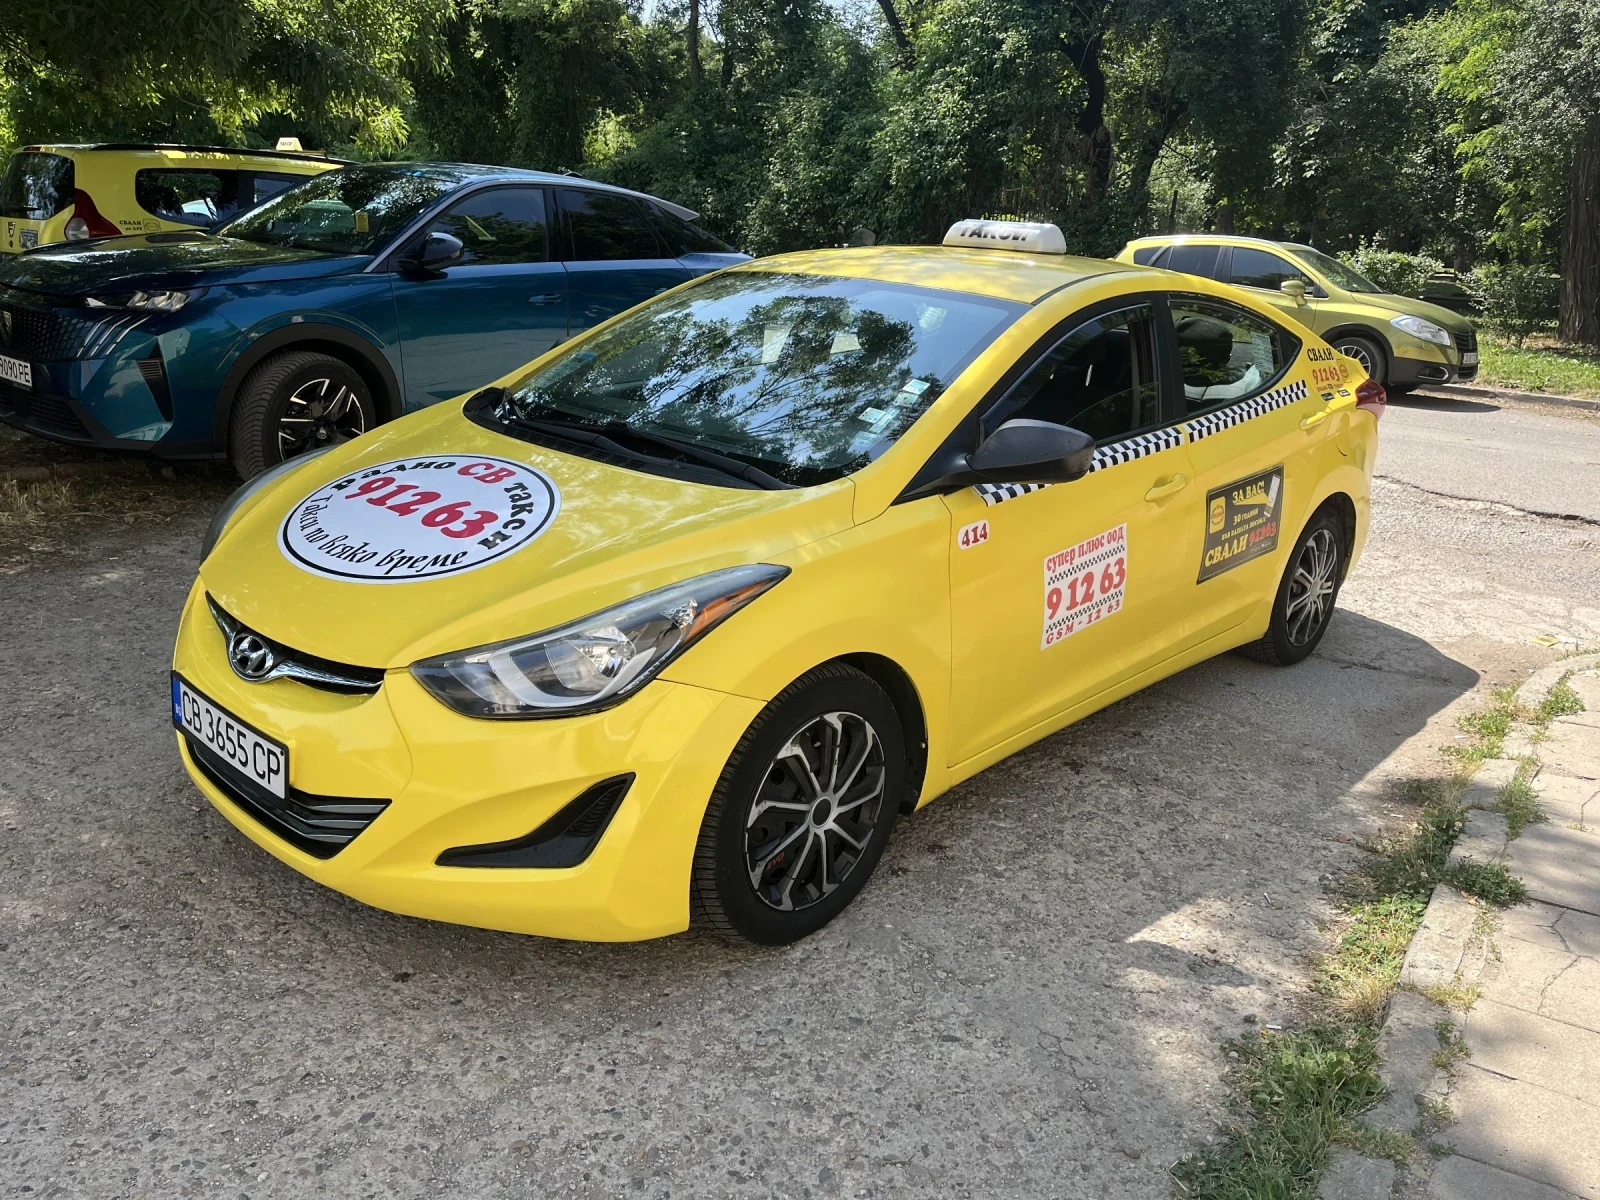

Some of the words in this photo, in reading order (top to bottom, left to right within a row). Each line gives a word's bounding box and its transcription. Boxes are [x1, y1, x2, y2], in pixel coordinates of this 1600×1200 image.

[1307, 347, 1334, 362] СВАЛИ
[1312, 366, 1340, 385] 91263
[457, 463, 517, 484] СВ
[1232, 489, 1245, 504] ЗА
[1246, 481, 1265, 498] ВАС!
[300, 494, 333, 531] Такси
[477, 482, 534, 550] такси
[304, 527, 330, 544] по
[962, 523, 988, 547] 414
[318, 534, 378, 564] всяко
[1046, 547, 1076, 574] супер
[1078, 537, 1105, 559] плюс
[1107, 526, 1125, 546] оод
[1204, 533, 1249, 568] СВАЛИ
[375, 549, 468, 575] време
[1046, 621, 1074, 646] GSM
[182, 690, 202, 734] CB
[205, 708, 249, 768] 3655
[253, 741, 281, 785] CP
